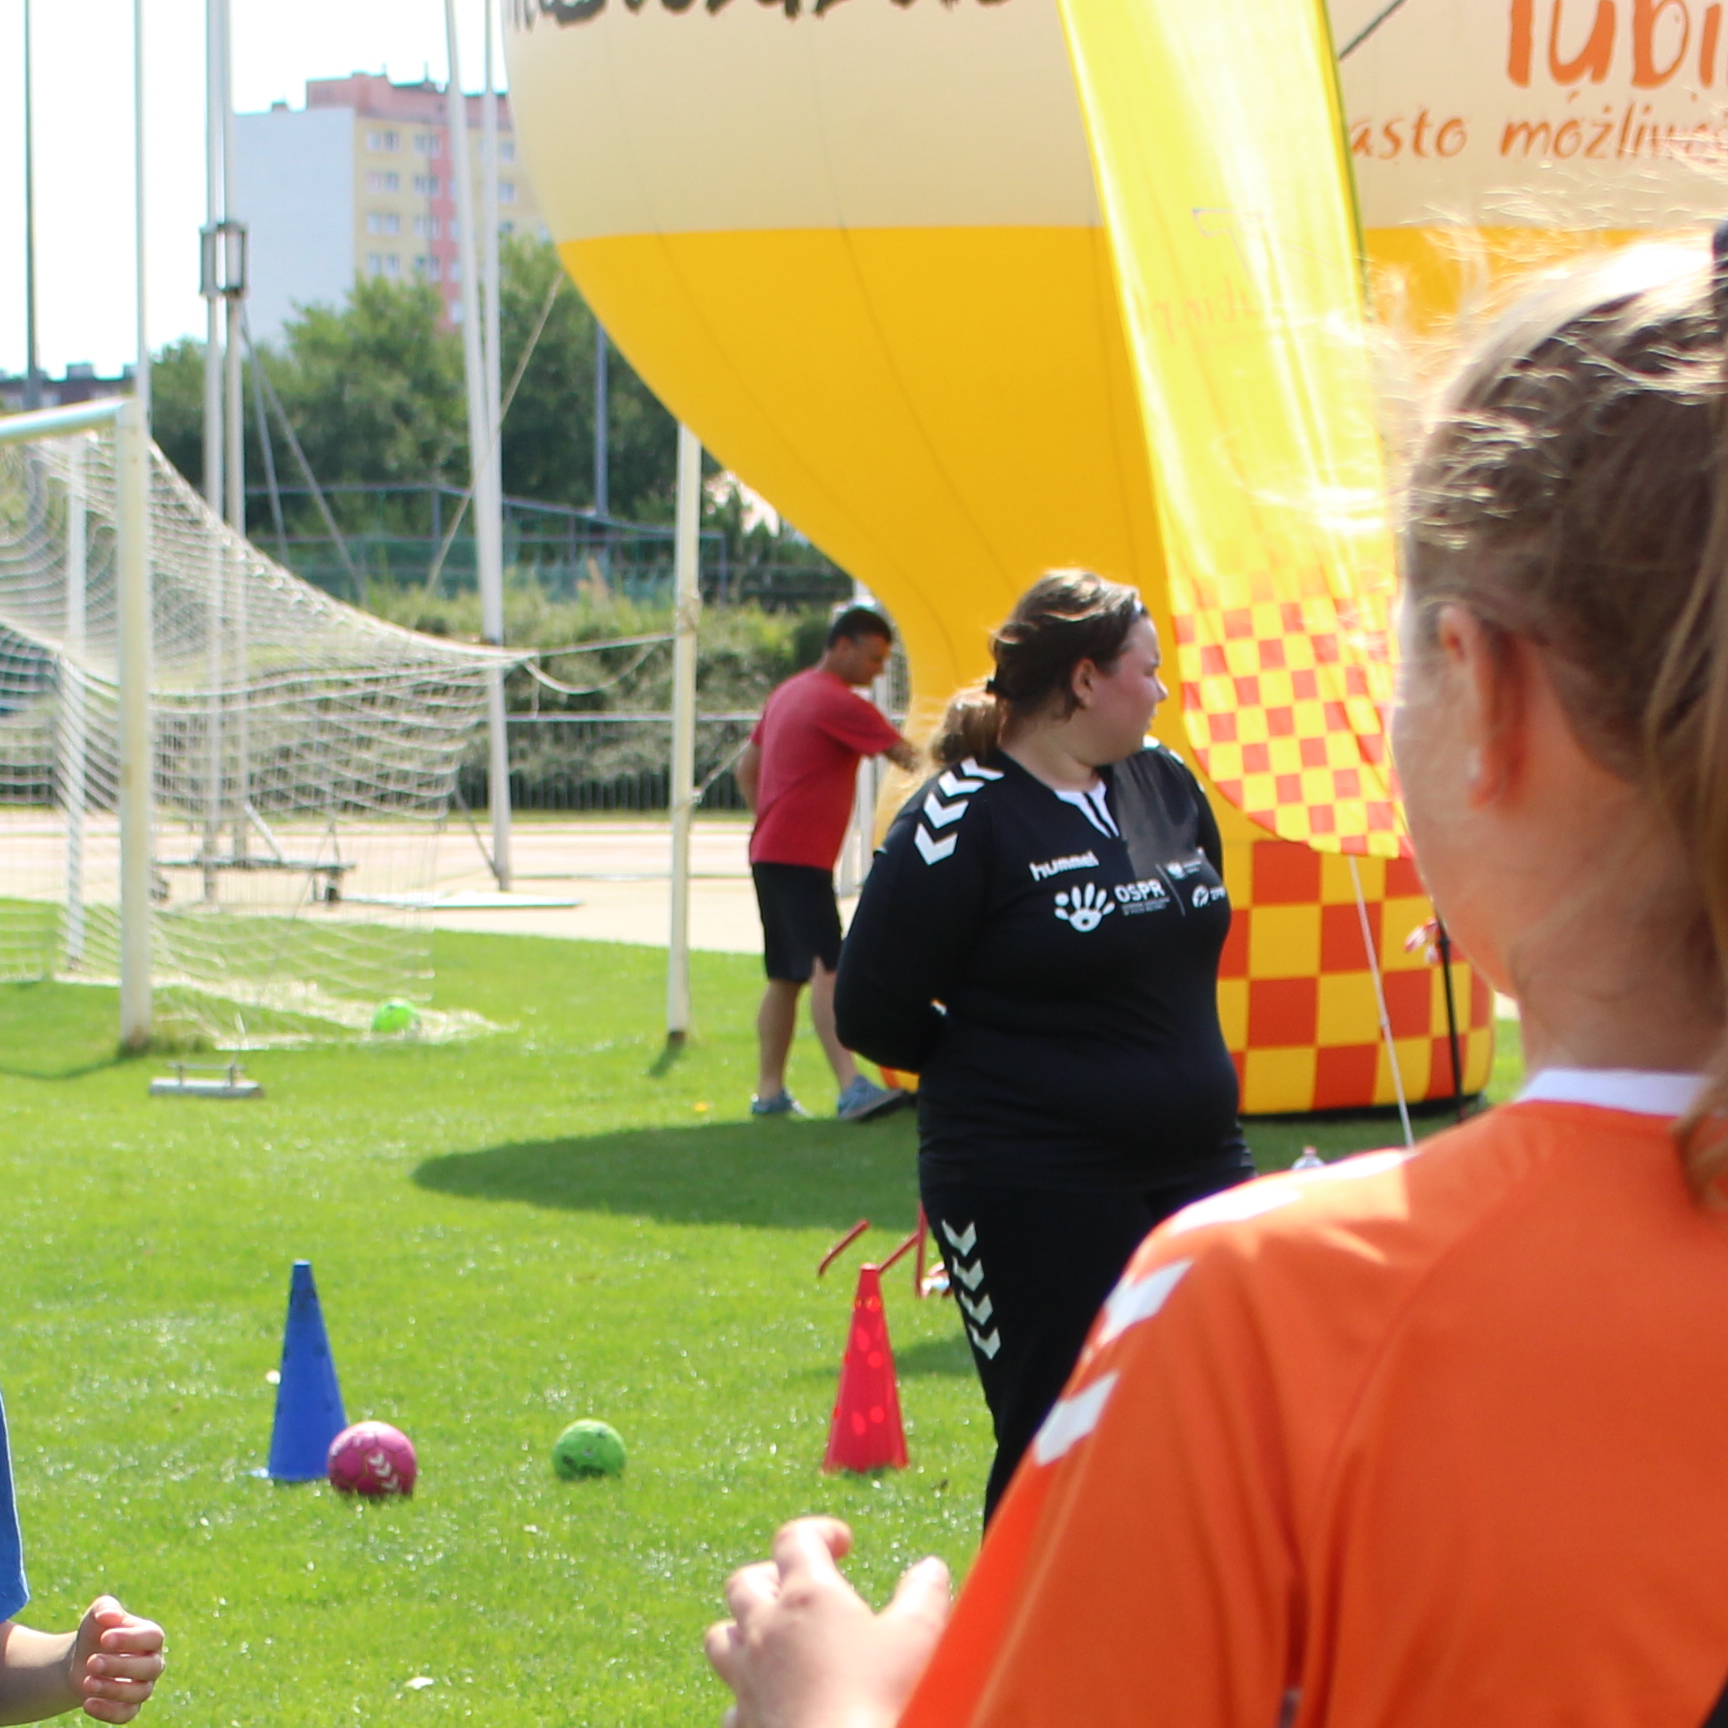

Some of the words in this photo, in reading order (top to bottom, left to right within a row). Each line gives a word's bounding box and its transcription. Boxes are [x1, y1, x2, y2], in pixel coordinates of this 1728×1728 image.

[1348, 108, 1469, 160] asto
[1028, 850, 1101, 882] hummel
[1114, 879, 1166, 903] OSPR
